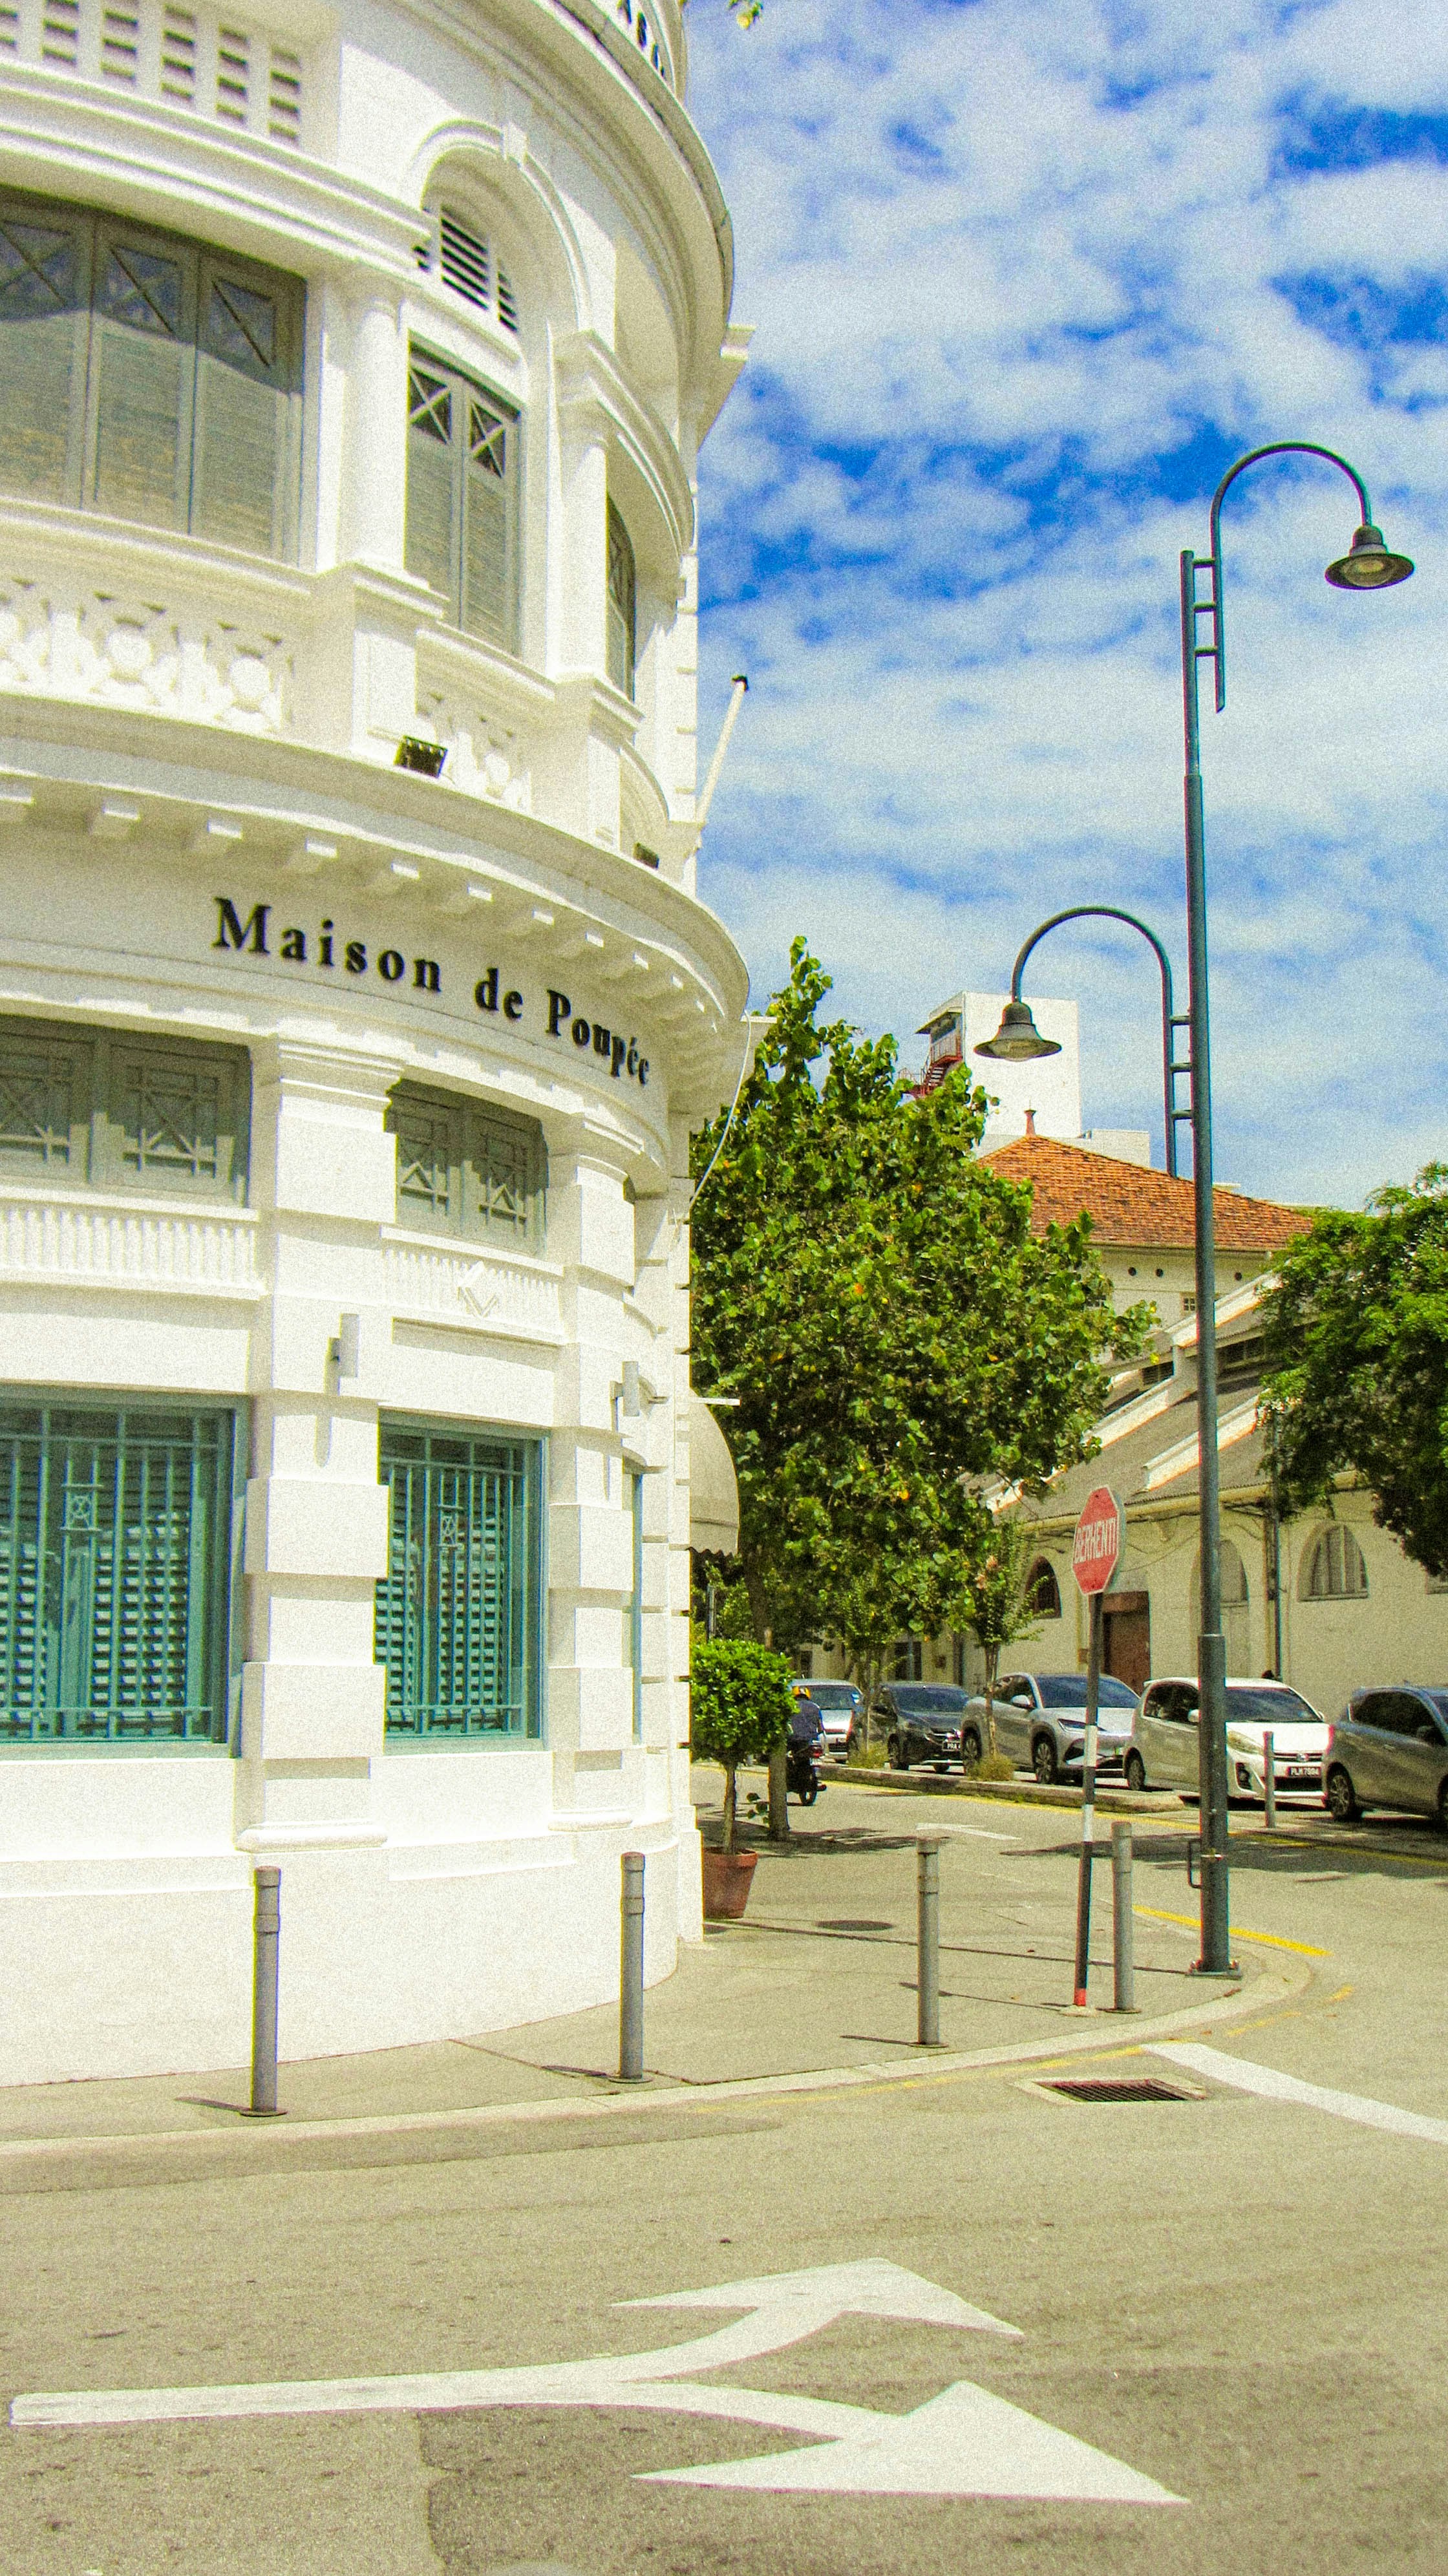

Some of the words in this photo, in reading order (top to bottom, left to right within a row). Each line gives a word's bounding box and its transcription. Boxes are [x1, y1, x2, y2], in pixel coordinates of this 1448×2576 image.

[212, 897, 442, 993] Maison
[474, 968, 524, 1020] de
[546, 988, 650, 1087] Poupée
[1074, 1517, 1116, 1564] BERHENTI
